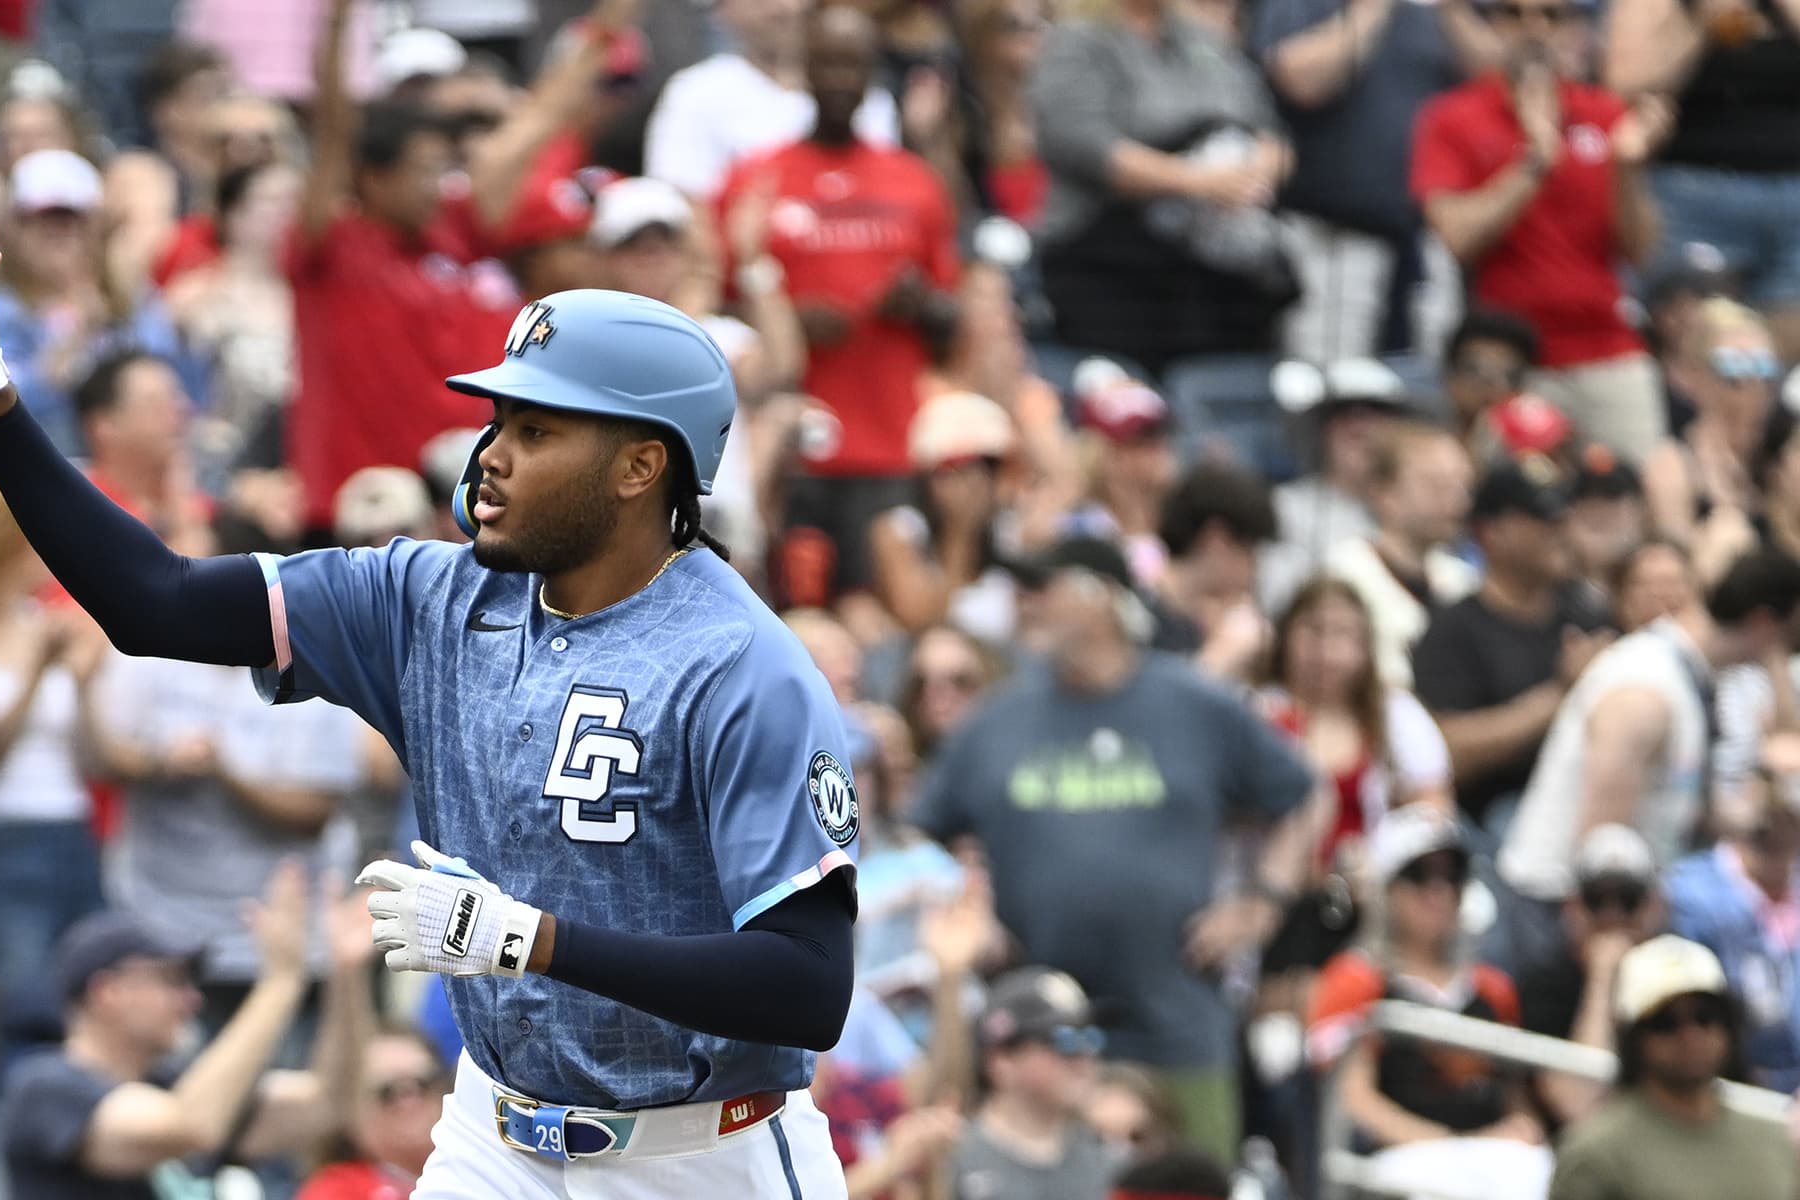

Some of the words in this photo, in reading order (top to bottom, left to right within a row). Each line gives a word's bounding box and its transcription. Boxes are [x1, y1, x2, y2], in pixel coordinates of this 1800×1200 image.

[814, 757, 825, 772] THE
[824, 778, 844, 820] W
[825, 822, 854, 841] COLUMBIA
[446, 893, 476, 954] Franklin
[535, 1125, 562, 1153] 29
